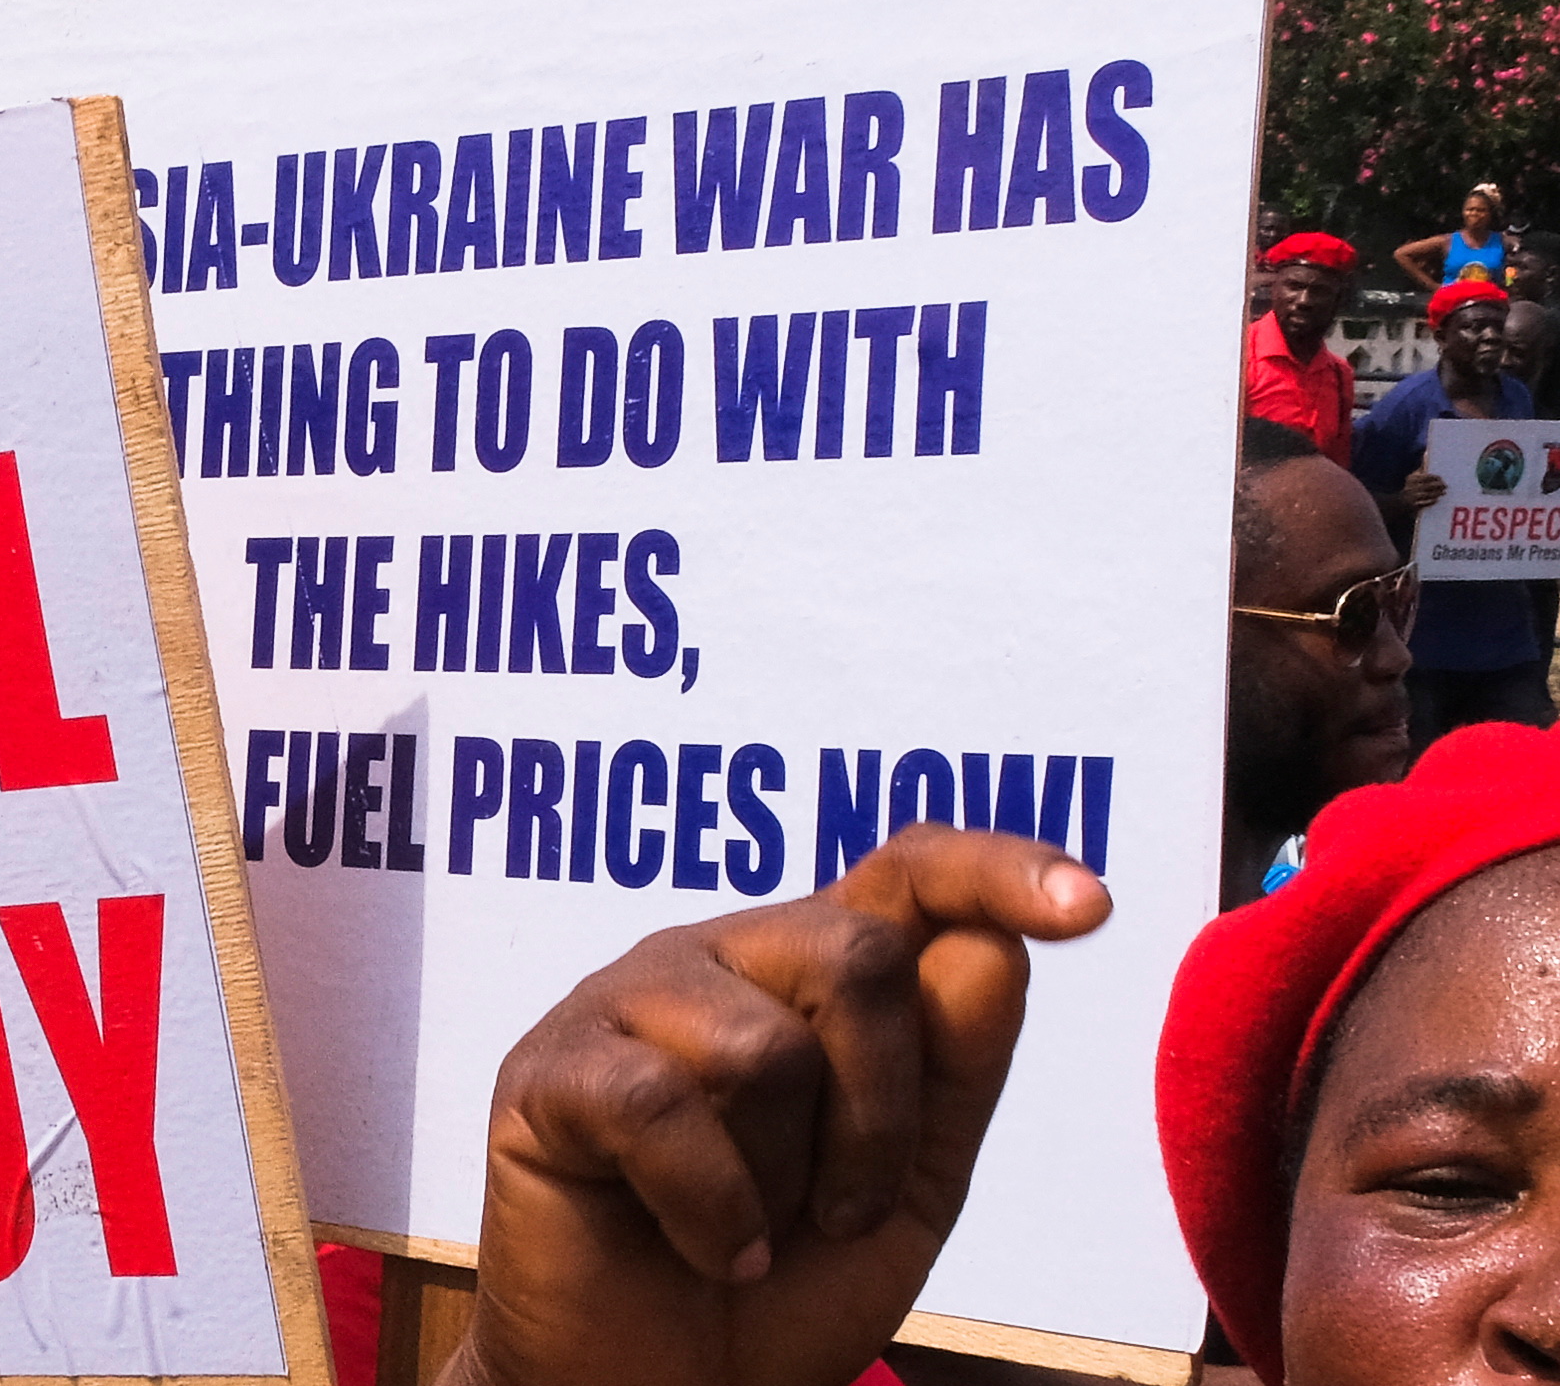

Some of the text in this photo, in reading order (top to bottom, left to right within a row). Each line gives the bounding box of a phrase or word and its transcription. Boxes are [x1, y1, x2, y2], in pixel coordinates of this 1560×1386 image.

[674, 91, 904, 254] WAR
[933, 60, 1152, 233] HAS
[425, 329, 532, 472] TO
[557, 320, 684, 468] DO
[714, 301, 987, 462] WITH
[246, 529, 699, 693] THE HIKES,
[1432, 545, 1503, 561] Ghanaians
[1507, 545, 1525, 560] Mr
[242, 727, 425, 872] FUEL
[449, 737, 785, 896] PRICES
